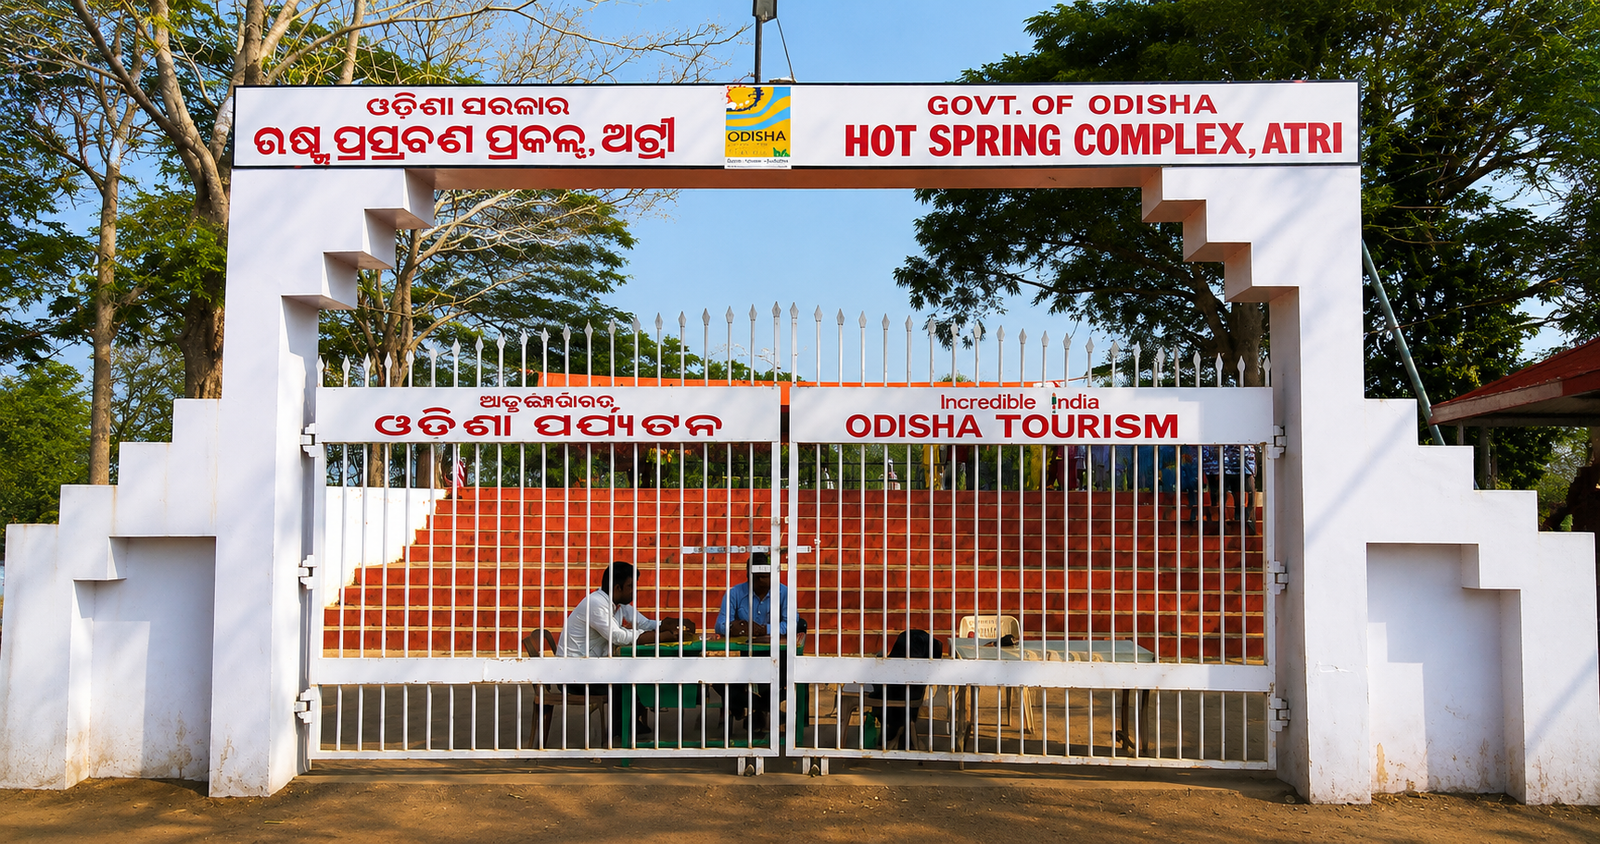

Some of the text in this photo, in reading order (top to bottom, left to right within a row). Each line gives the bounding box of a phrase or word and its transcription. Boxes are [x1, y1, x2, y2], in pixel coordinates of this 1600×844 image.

[928, 94, 1218, 116] GOVT. OF ODISHA
[728, 130, 786, 142] ODISHA
[845, 122, 1343, 159] HOT SPRING COMPLEX, ATRI
[941, 394, 1037, 410] Incredible
[846, 414, 1179, 438] ODISHA TOURISM
